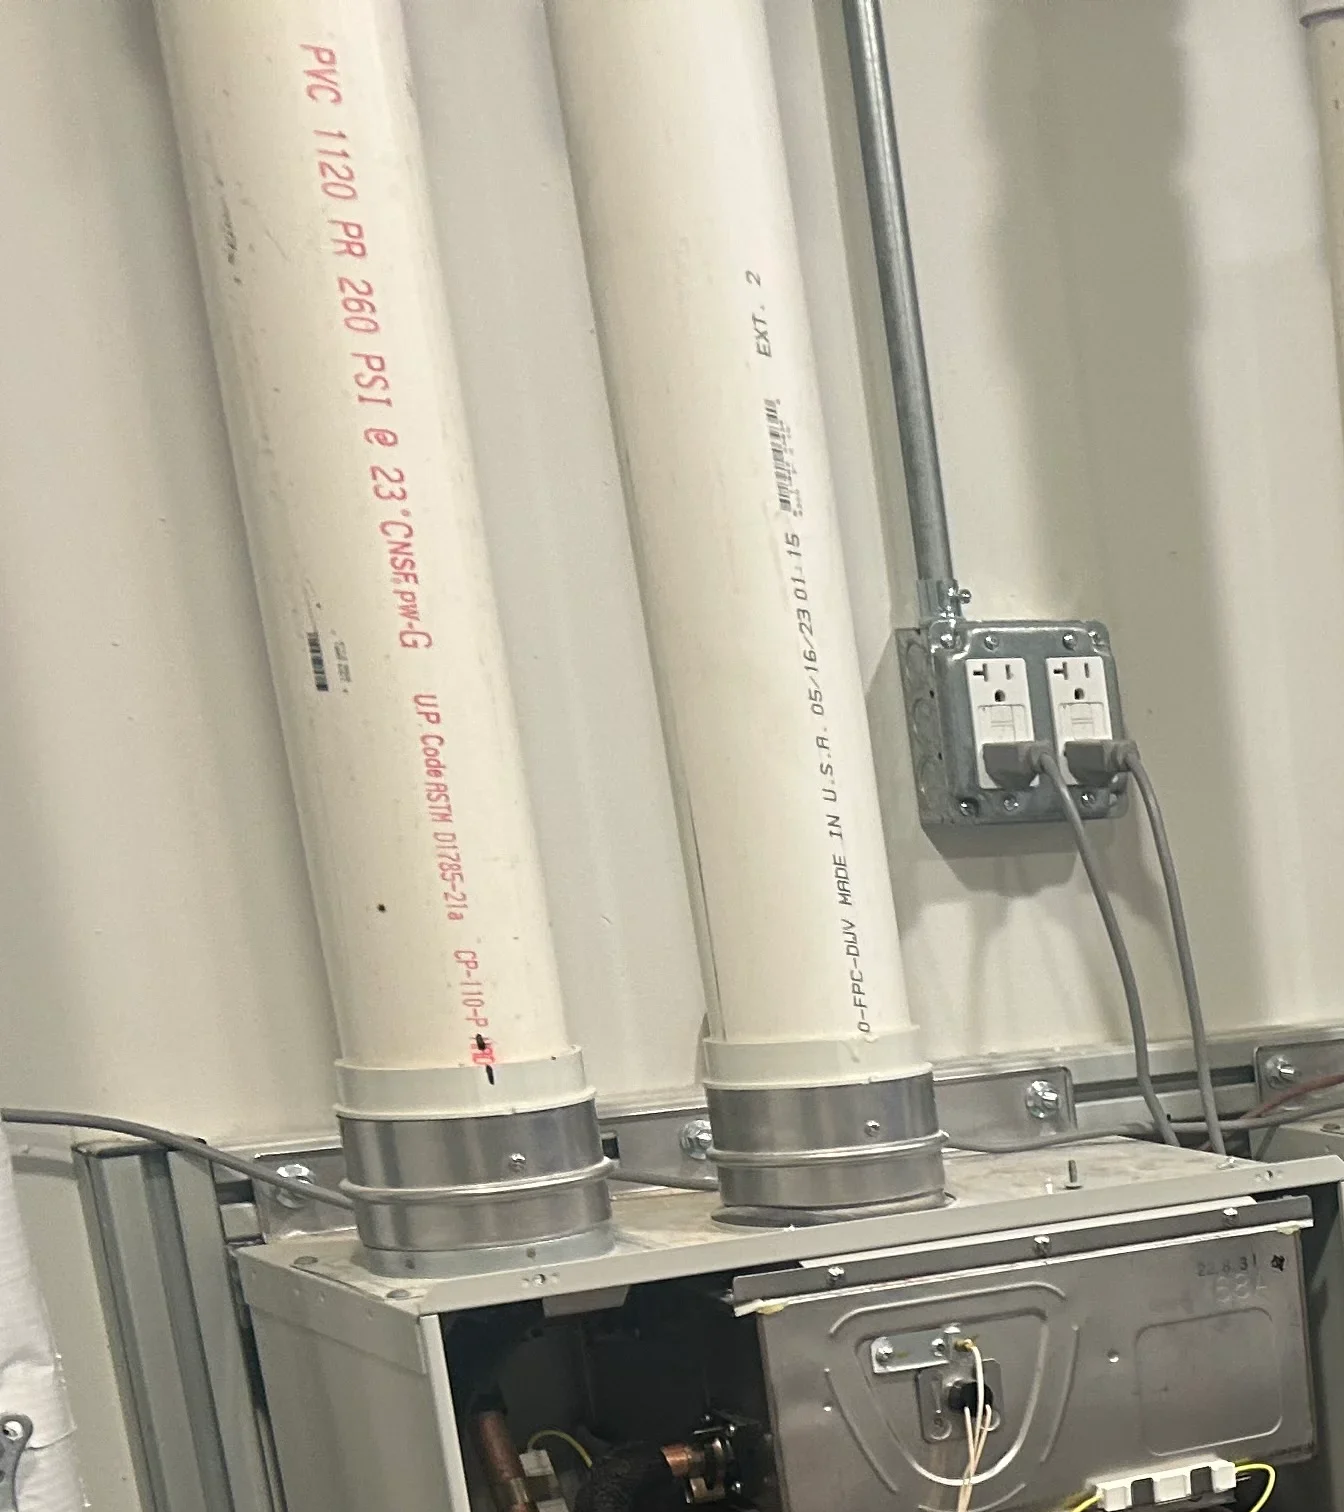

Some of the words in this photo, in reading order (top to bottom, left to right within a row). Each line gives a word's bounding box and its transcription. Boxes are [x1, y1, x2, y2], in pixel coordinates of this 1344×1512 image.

[300, 44, 342, 104] PVC
[314, 129, 357, 200] 1120
[328, 219, 367, 260] PR
[338, 276, 380, 334] 260
[745, 270, 761, 286] 2
[350, 352, 393, 407] PSI
[364, 427, 398, 447] @
[797, 609, 825, 716] 05/16/23
[828, 814, 845, 840] IN
[834, 854, 852, 905] MADE
[454, 949, 489, 1028] CP-110-P
